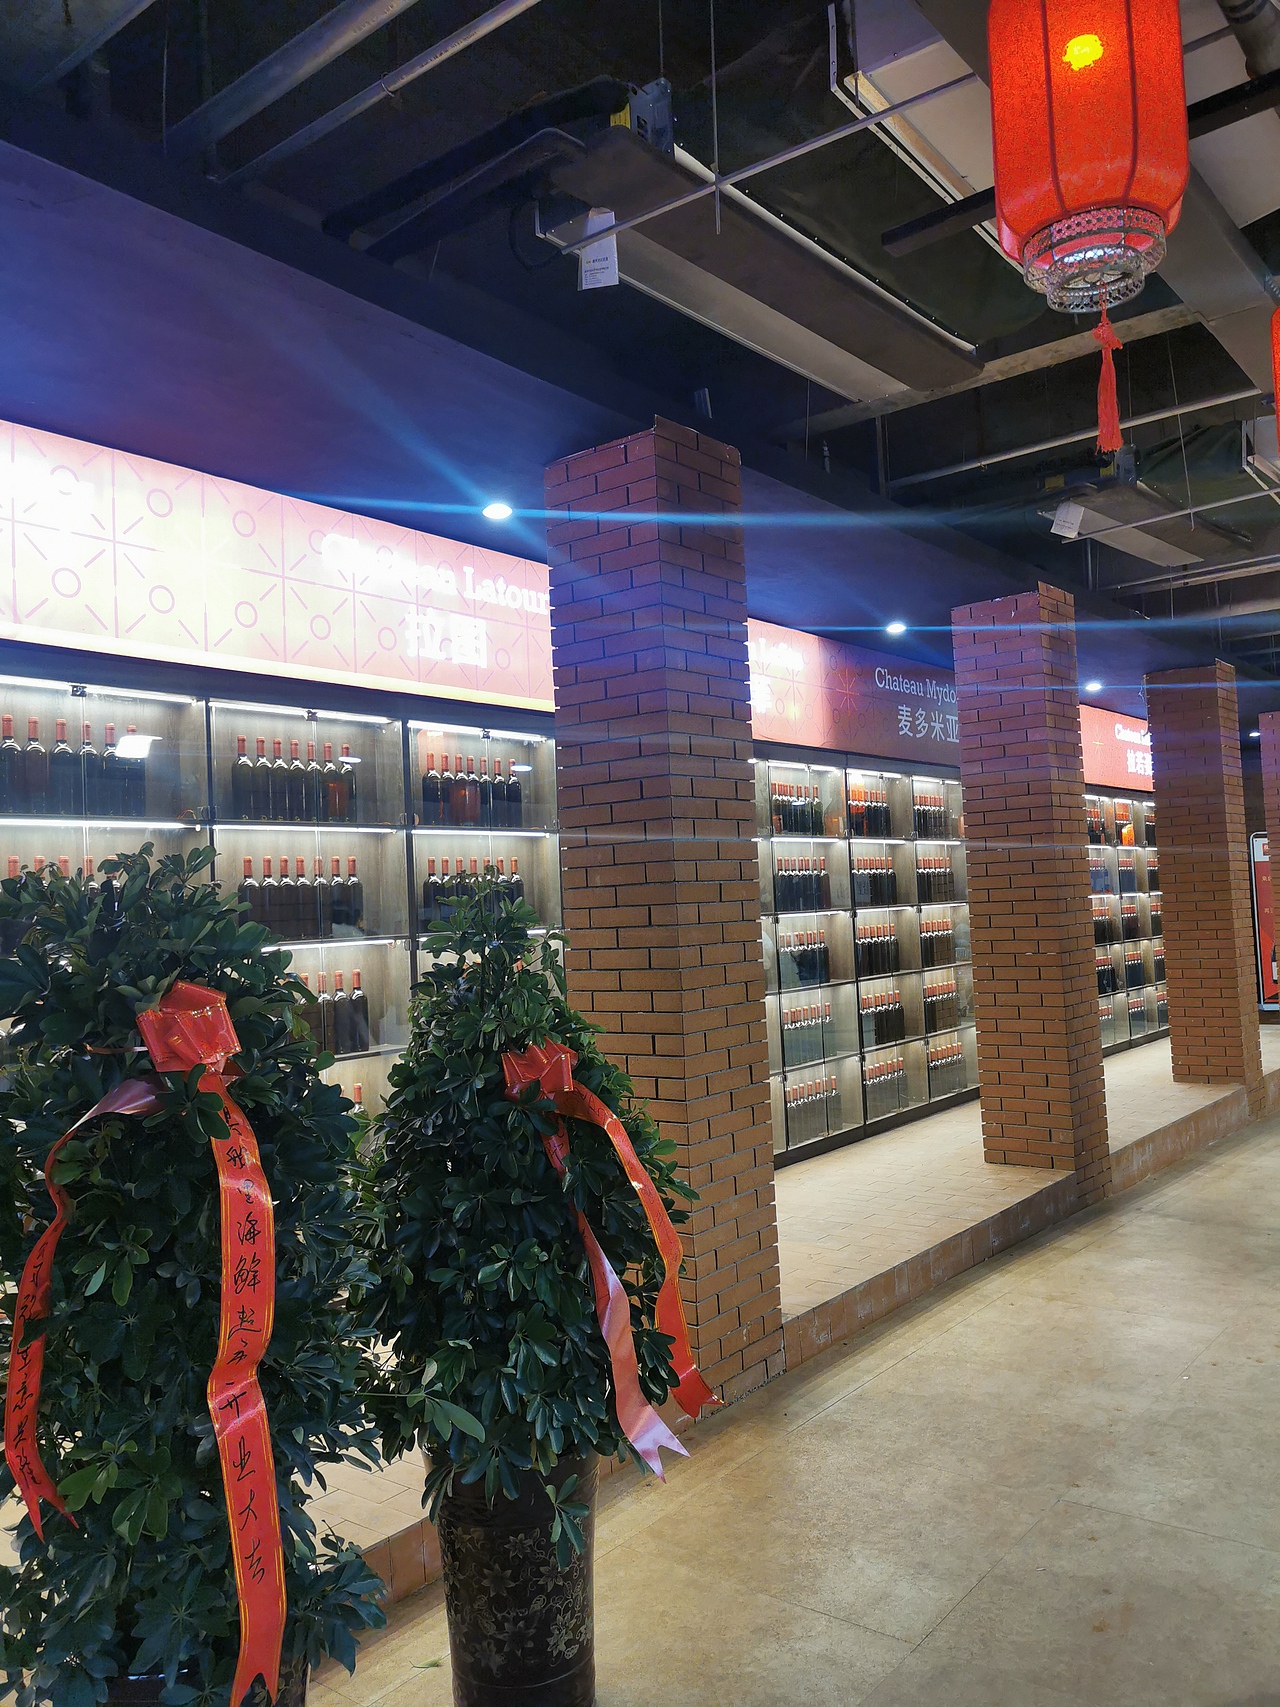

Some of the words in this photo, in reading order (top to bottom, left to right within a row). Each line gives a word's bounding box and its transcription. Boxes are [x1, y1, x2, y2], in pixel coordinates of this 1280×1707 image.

[463, 566, 549, 615] Latour
[875, 667, 924, 697] Chateau
[925, 679, 957, 705] Mydo
[898, 704, 959, 743] 麦多米亚
